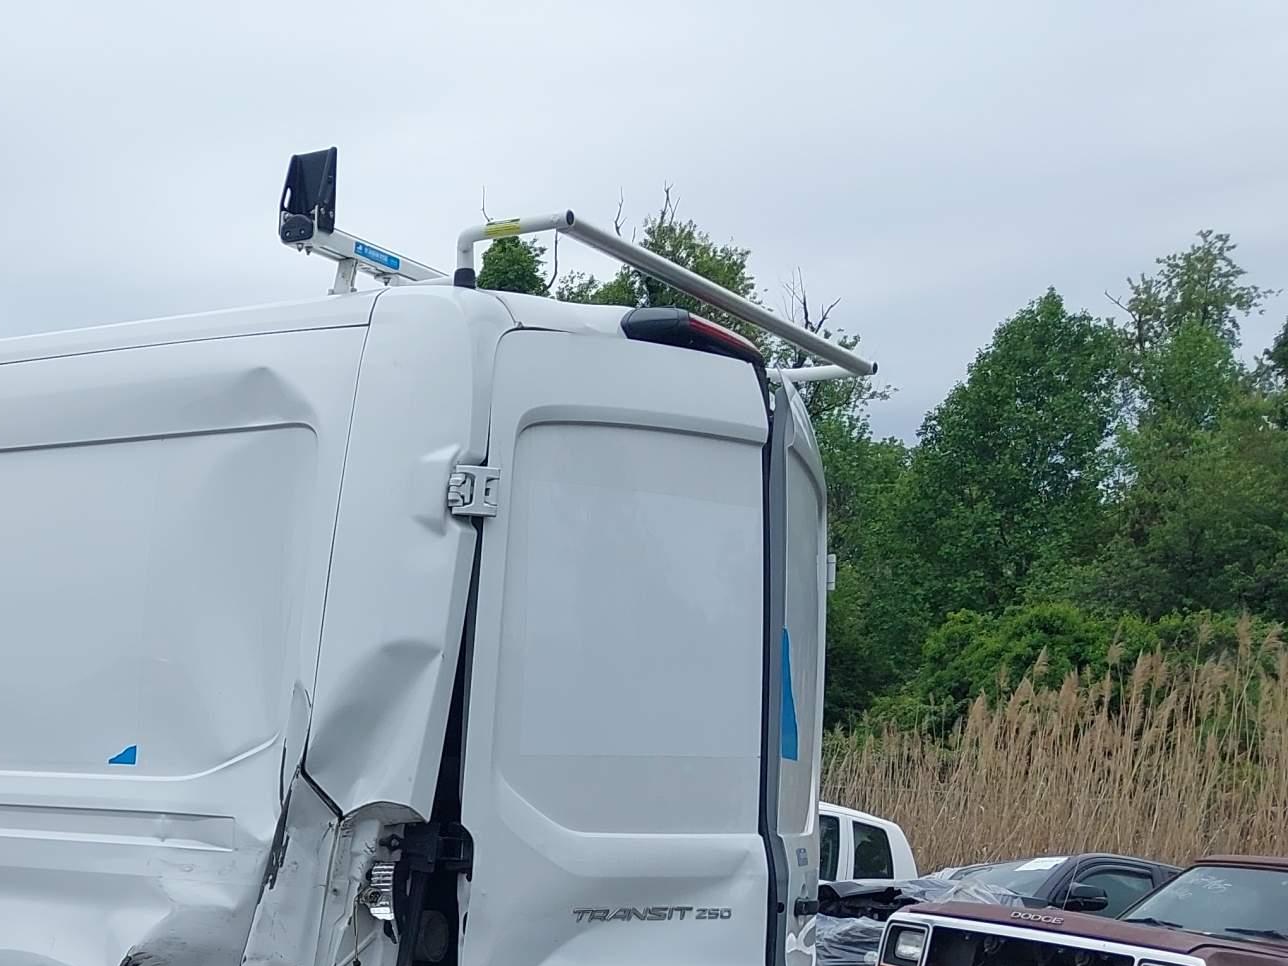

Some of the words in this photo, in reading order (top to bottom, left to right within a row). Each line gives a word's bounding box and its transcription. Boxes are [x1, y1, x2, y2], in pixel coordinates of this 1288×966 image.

[573, 906, 693, 922] TRANSIT
[695, 907, 732, 920] 250
[1009, 909, 1065, 926] DODGE
